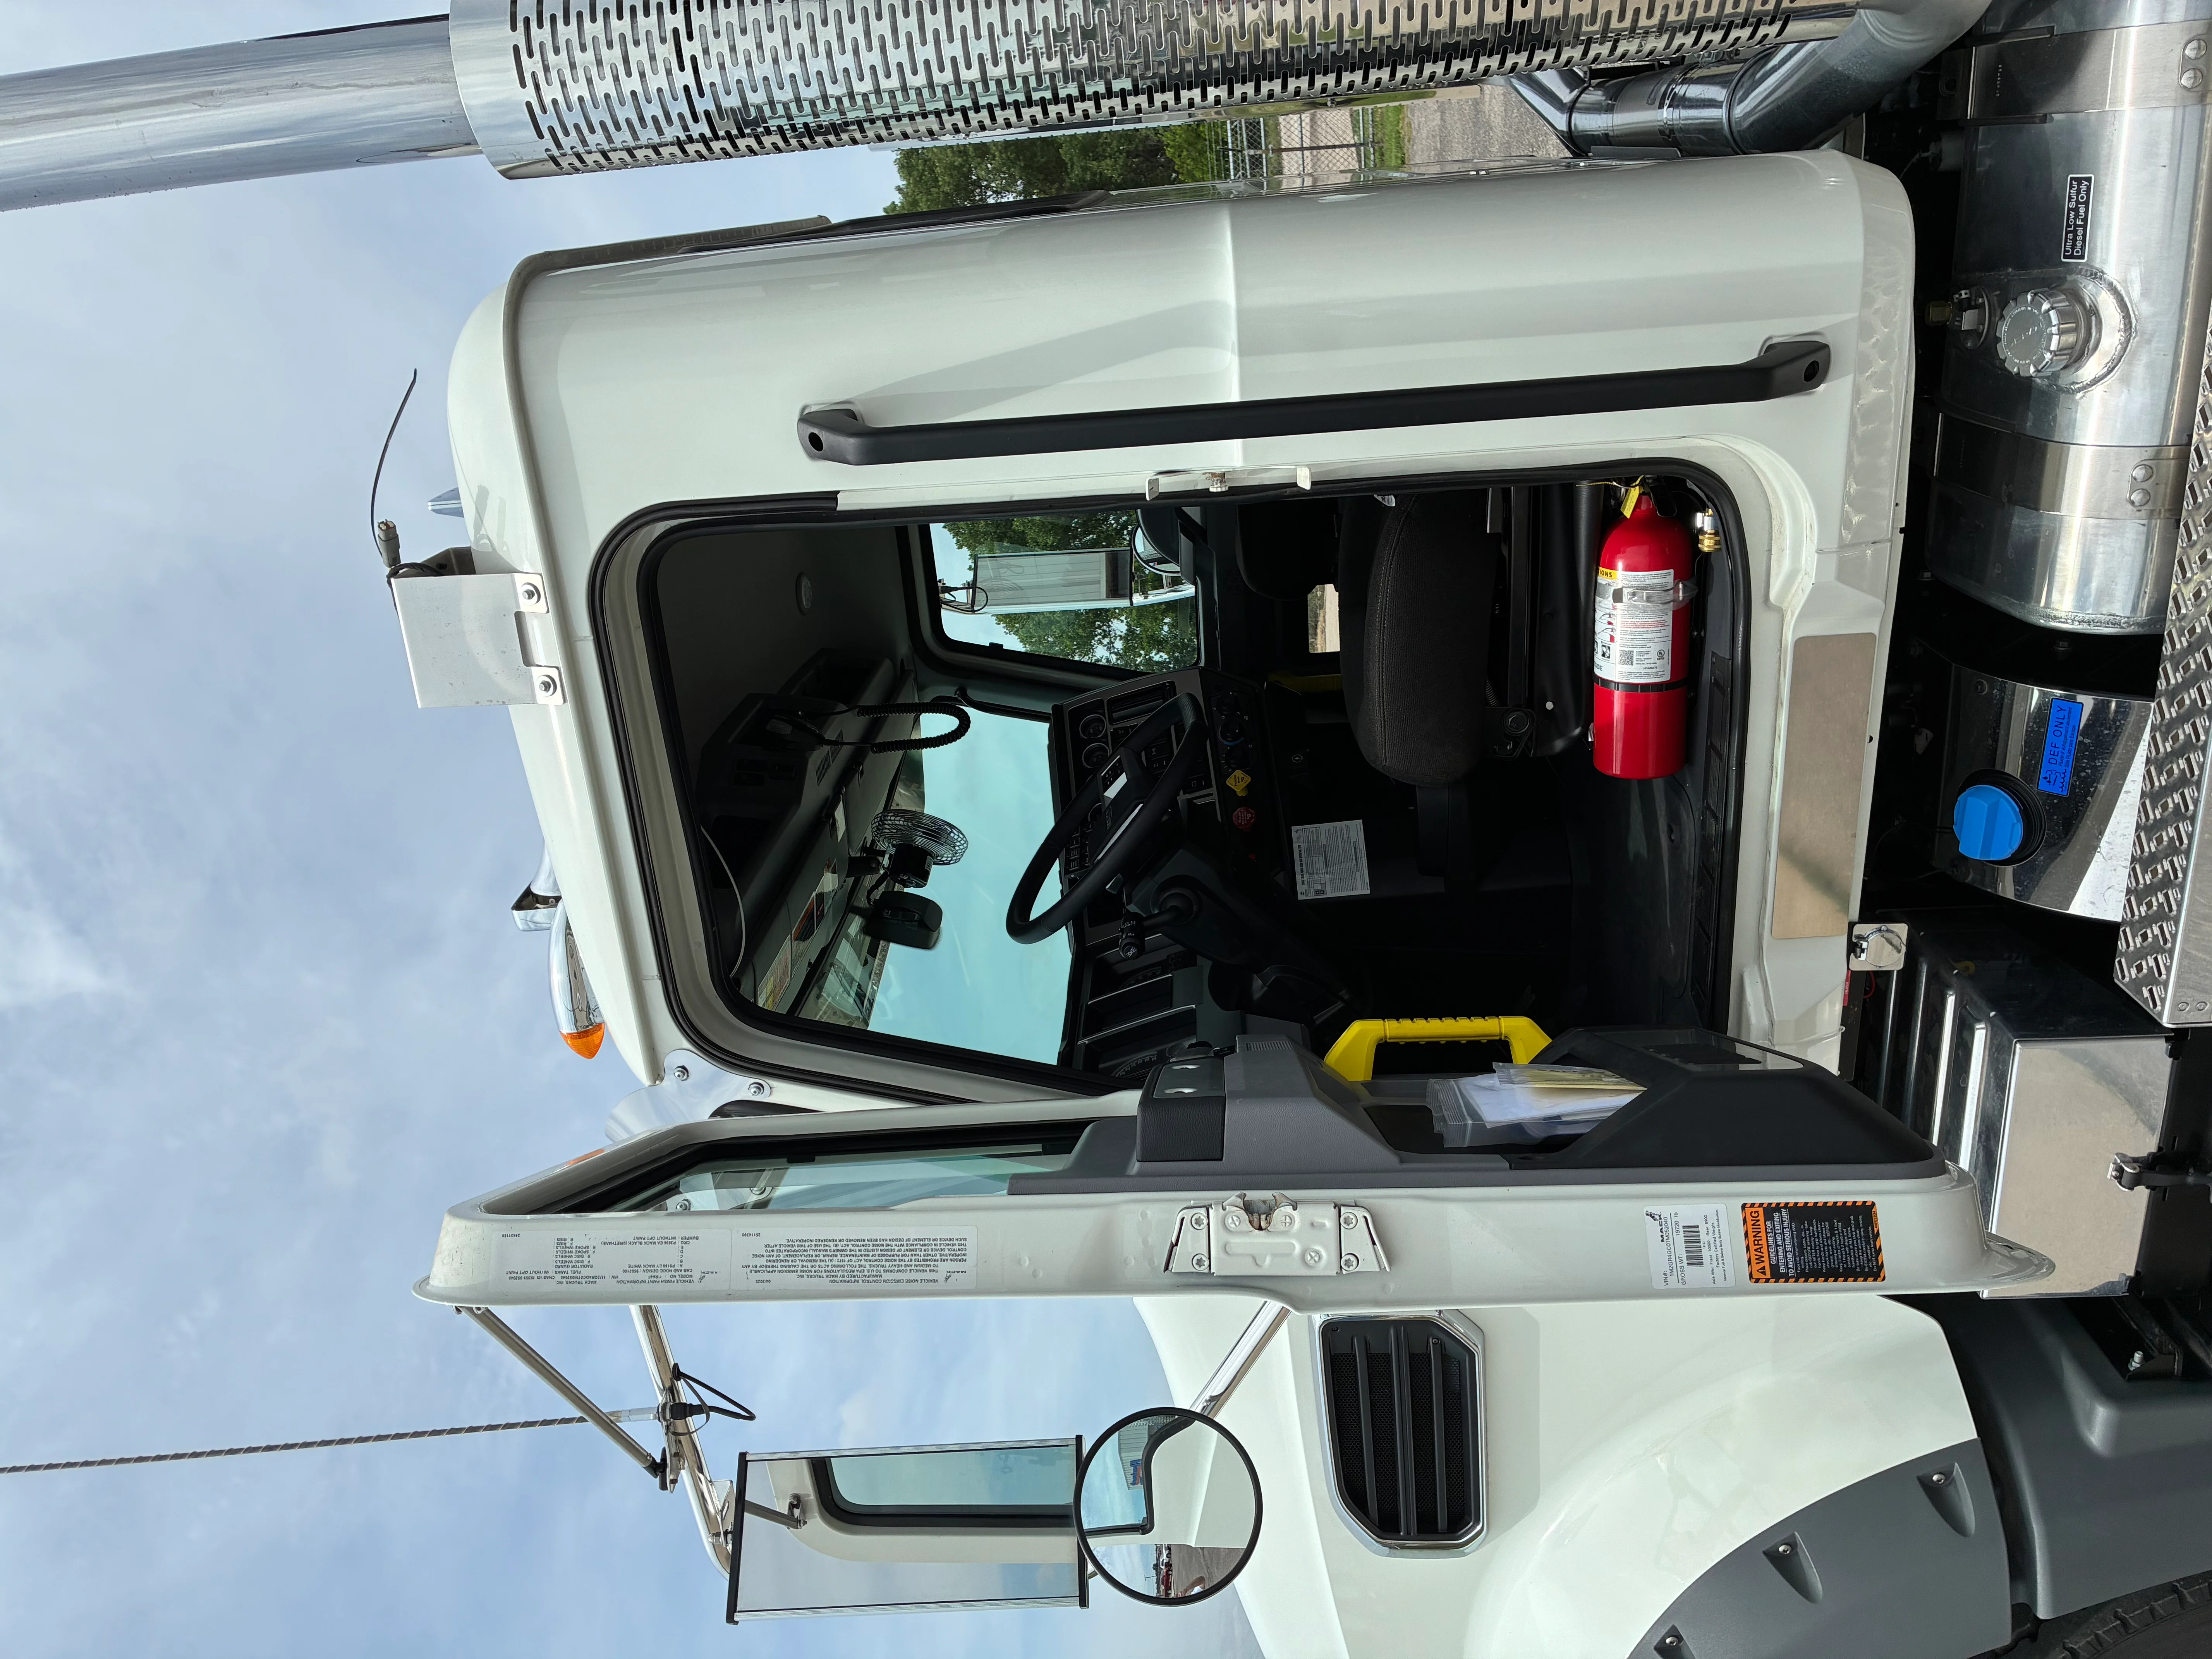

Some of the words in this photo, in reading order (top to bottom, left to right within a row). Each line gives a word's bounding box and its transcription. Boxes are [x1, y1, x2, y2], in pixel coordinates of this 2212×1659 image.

[2069, 180, 2077, 208] Sulfur
[2078, 180, 2089, 202] Only
[2076, 204, 2085, 224] Fuel
[2074, 227, 2083, 255] Diesel
[2053, 706, 2066, 737] ONLY
[2048, 742, 2060, 765] DEF
[1773, 1212, 1781, 1233] EXITING
[1781, 1208, 1790, 1227] INJURY
[1750, 1210, 1764, 1264] WARNING
[1767, 1233, 1776, 1264] GUIDELINES
[1784, 1228, 1792, 1251] SERIOUS
[1777, 1246, 1785, 1273] ENTERING
